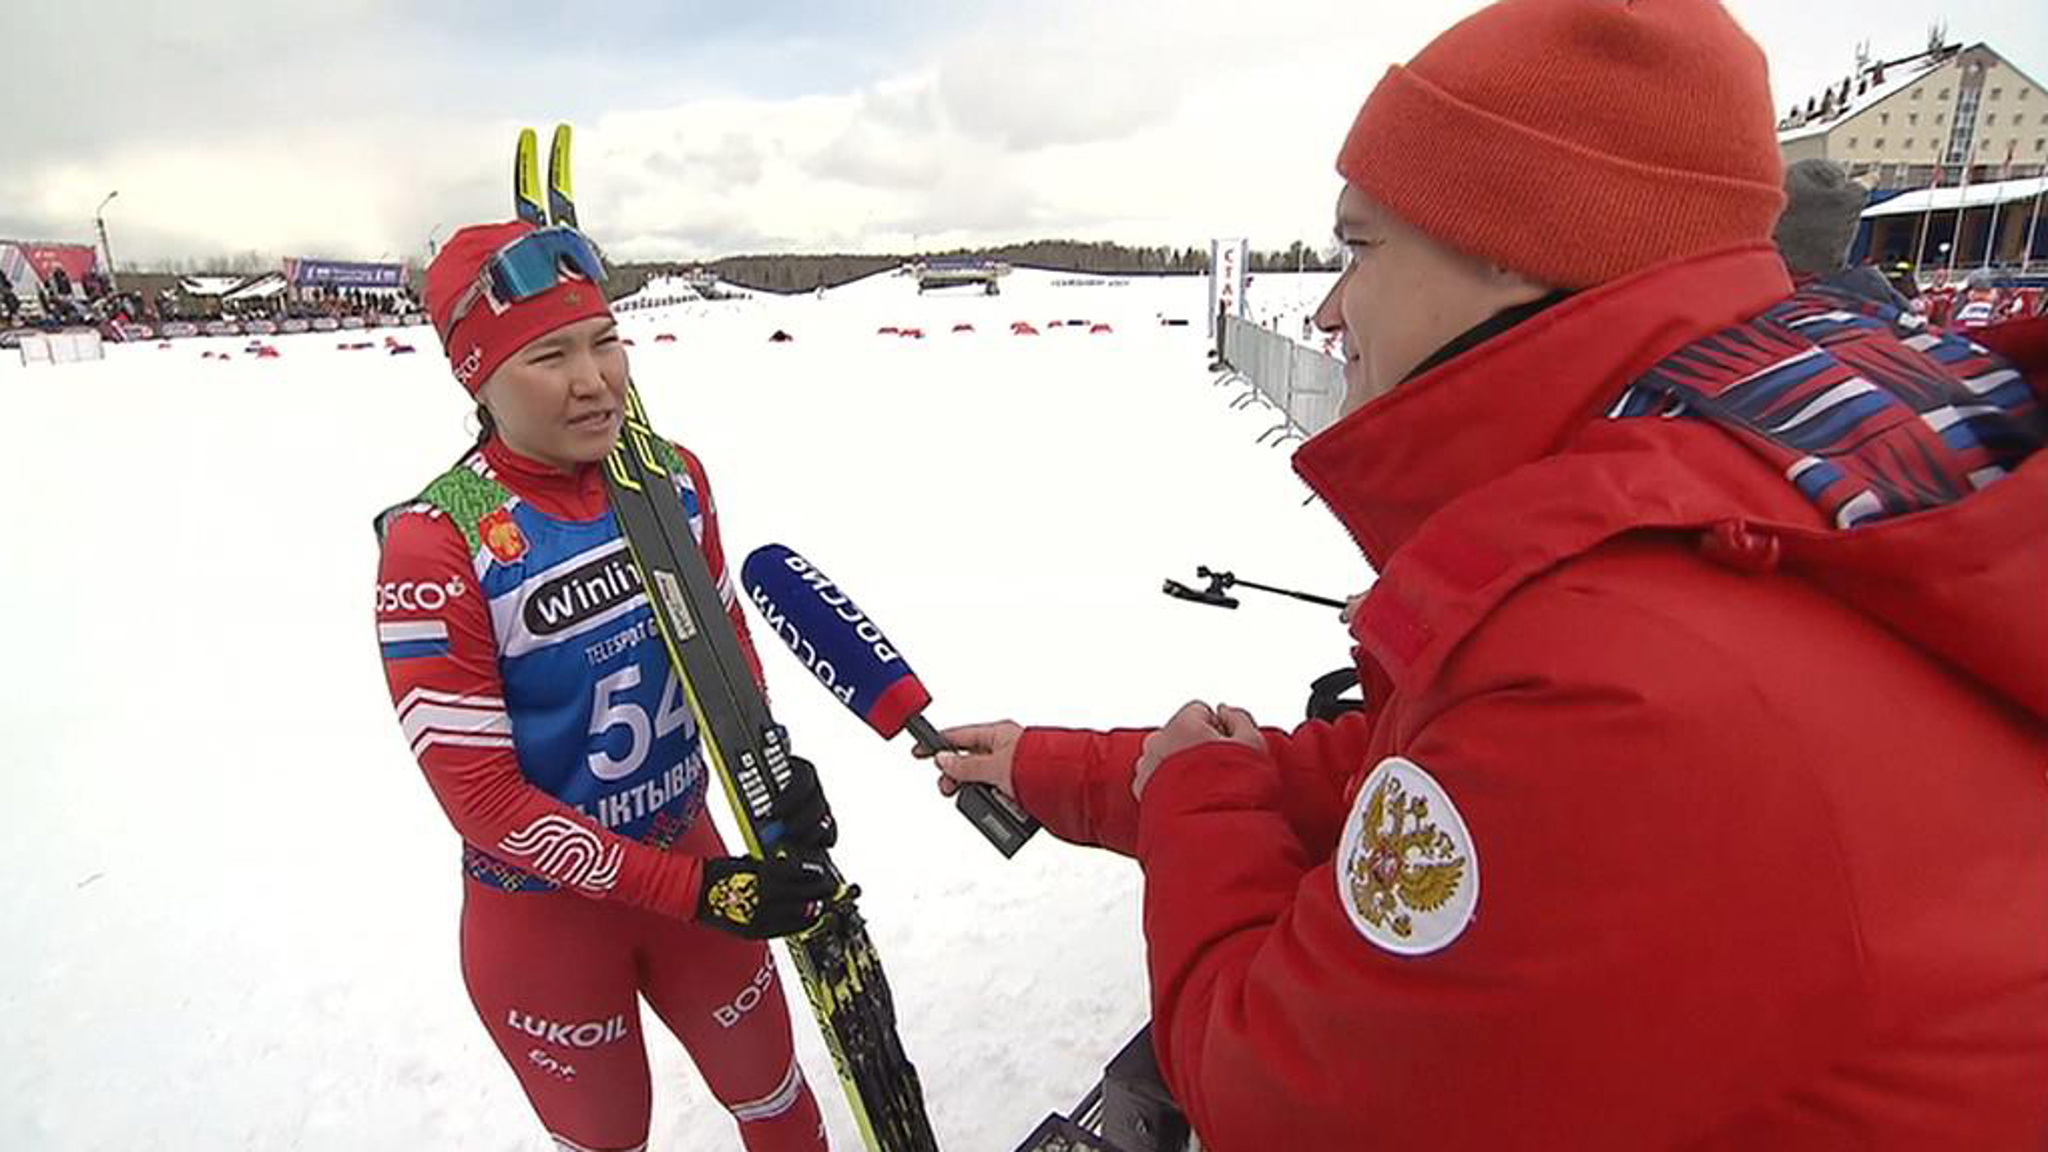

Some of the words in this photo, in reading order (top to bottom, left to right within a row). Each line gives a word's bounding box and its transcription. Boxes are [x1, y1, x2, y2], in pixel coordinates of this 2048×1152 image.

[784, 554, 900, 663] РОССИЯ
[588, 663, 696, 780] 54
[508, 1010, 628, 1047] LUKOIL
